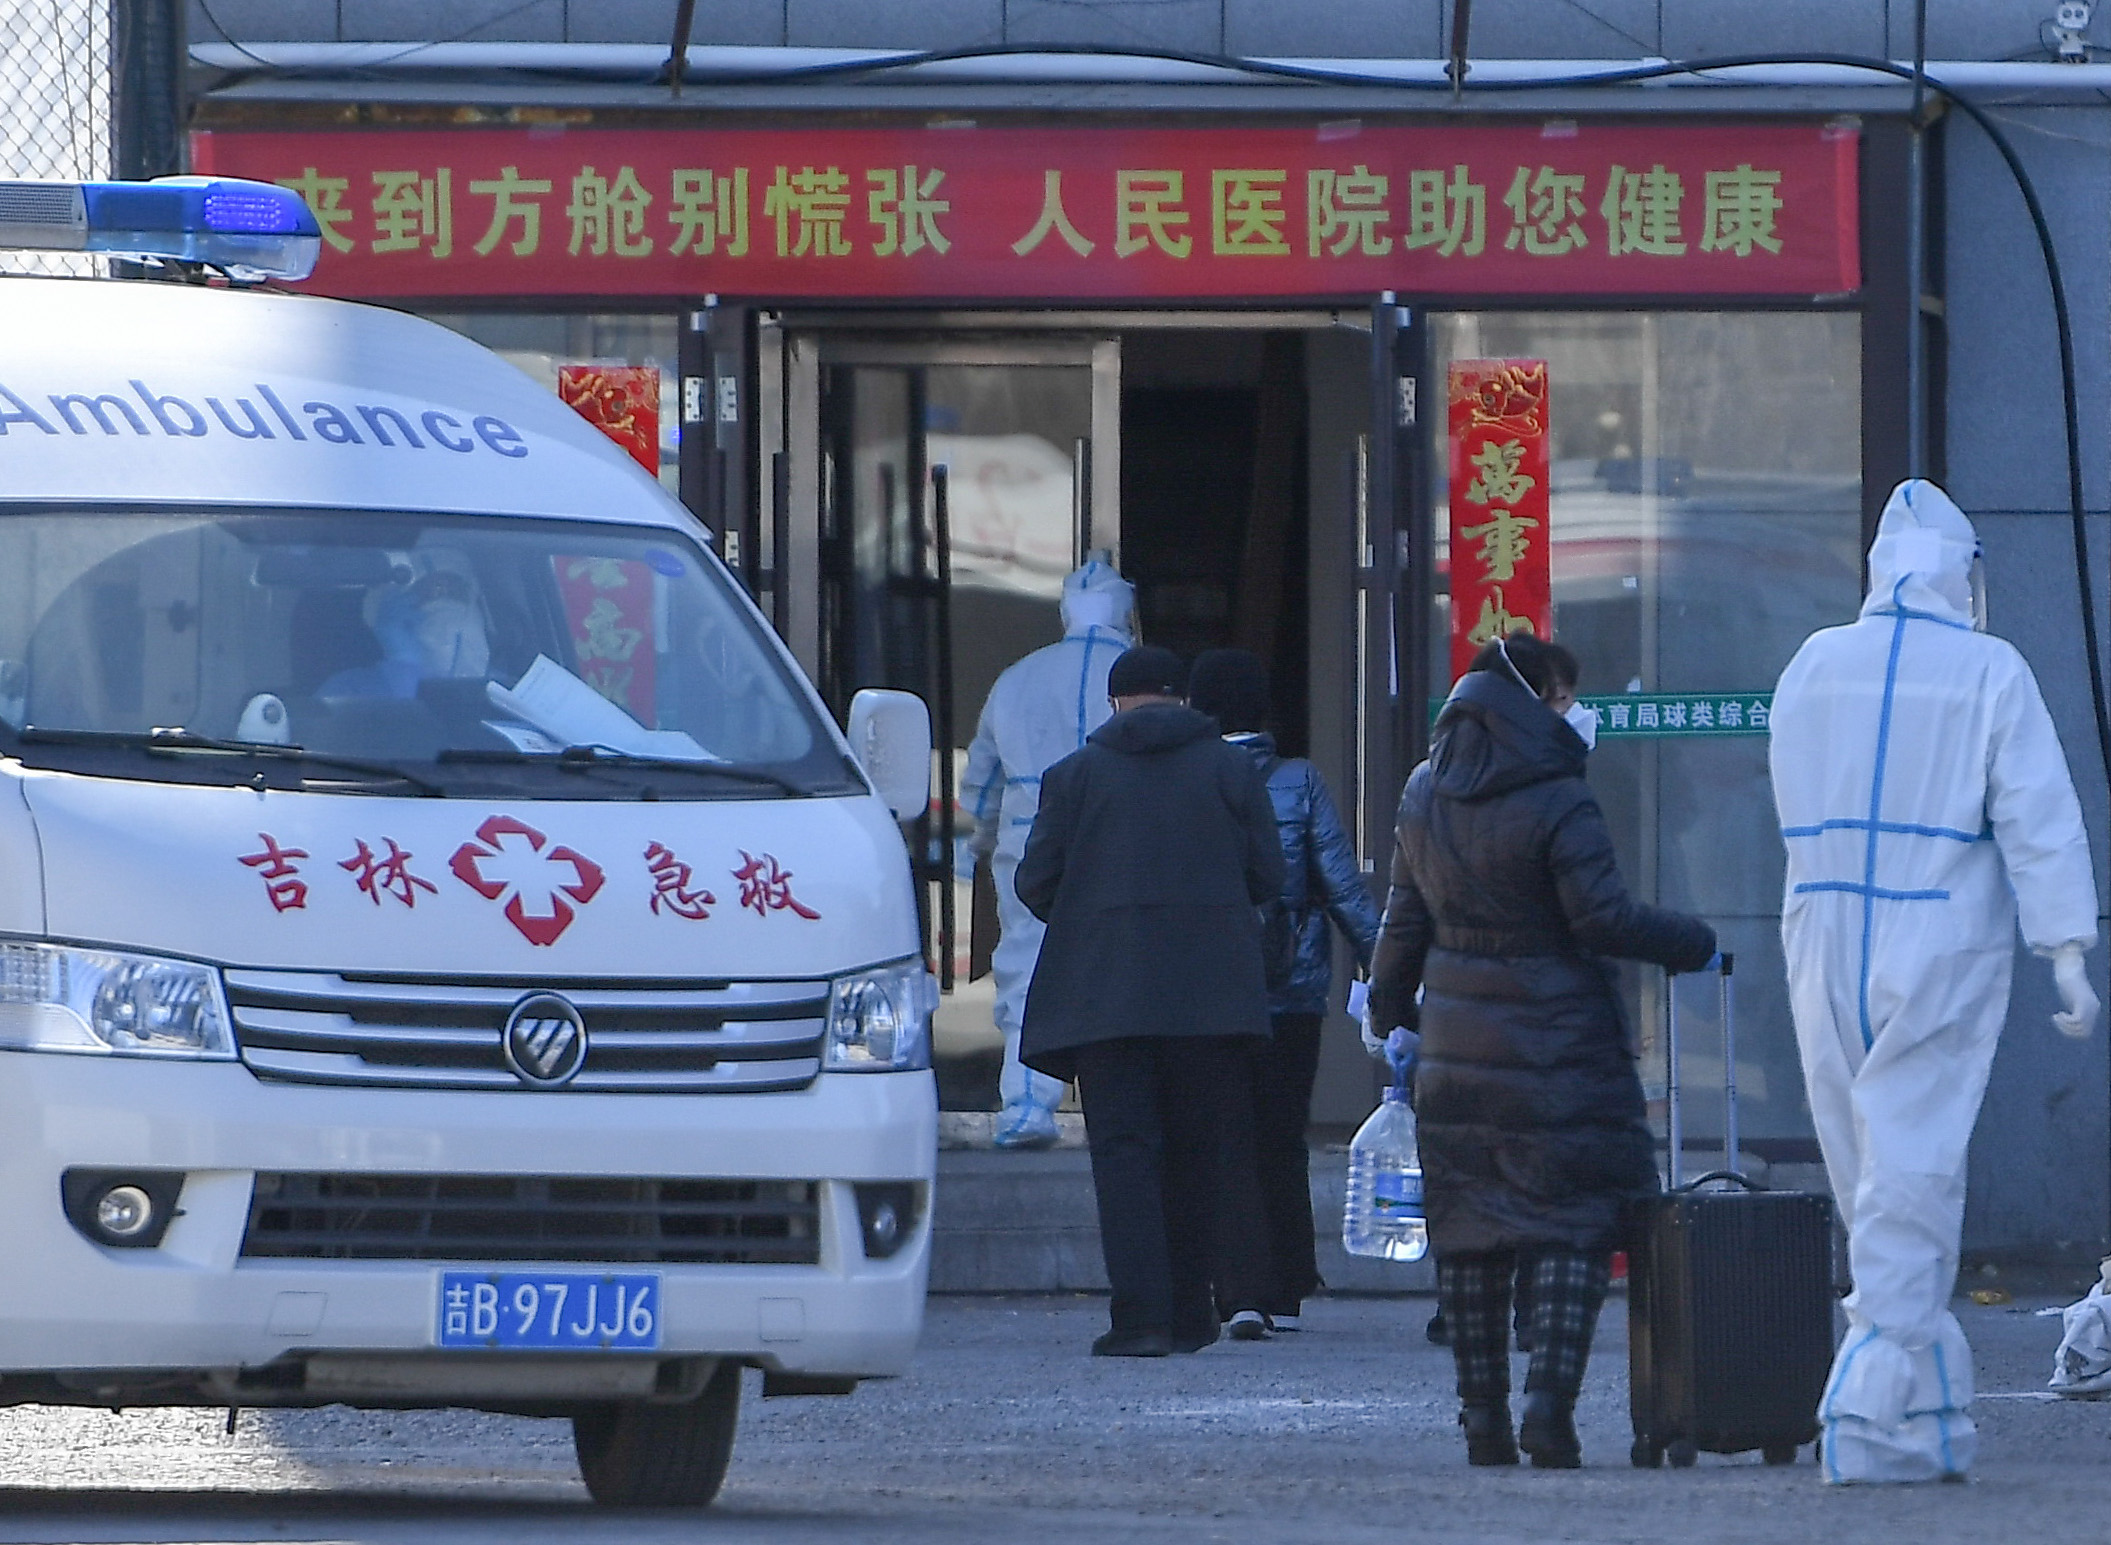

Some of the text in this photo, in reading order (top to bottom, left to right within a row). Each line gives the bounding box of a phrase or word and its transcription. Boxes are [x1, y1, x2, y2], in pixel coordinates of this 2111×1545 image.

[275, 164, 1784, 259] 来到方舱别慌张 人民医院助您健康
[0, 378, 529, 458] Ambulance
[237, 831, 823, 920] 吉林 急救
